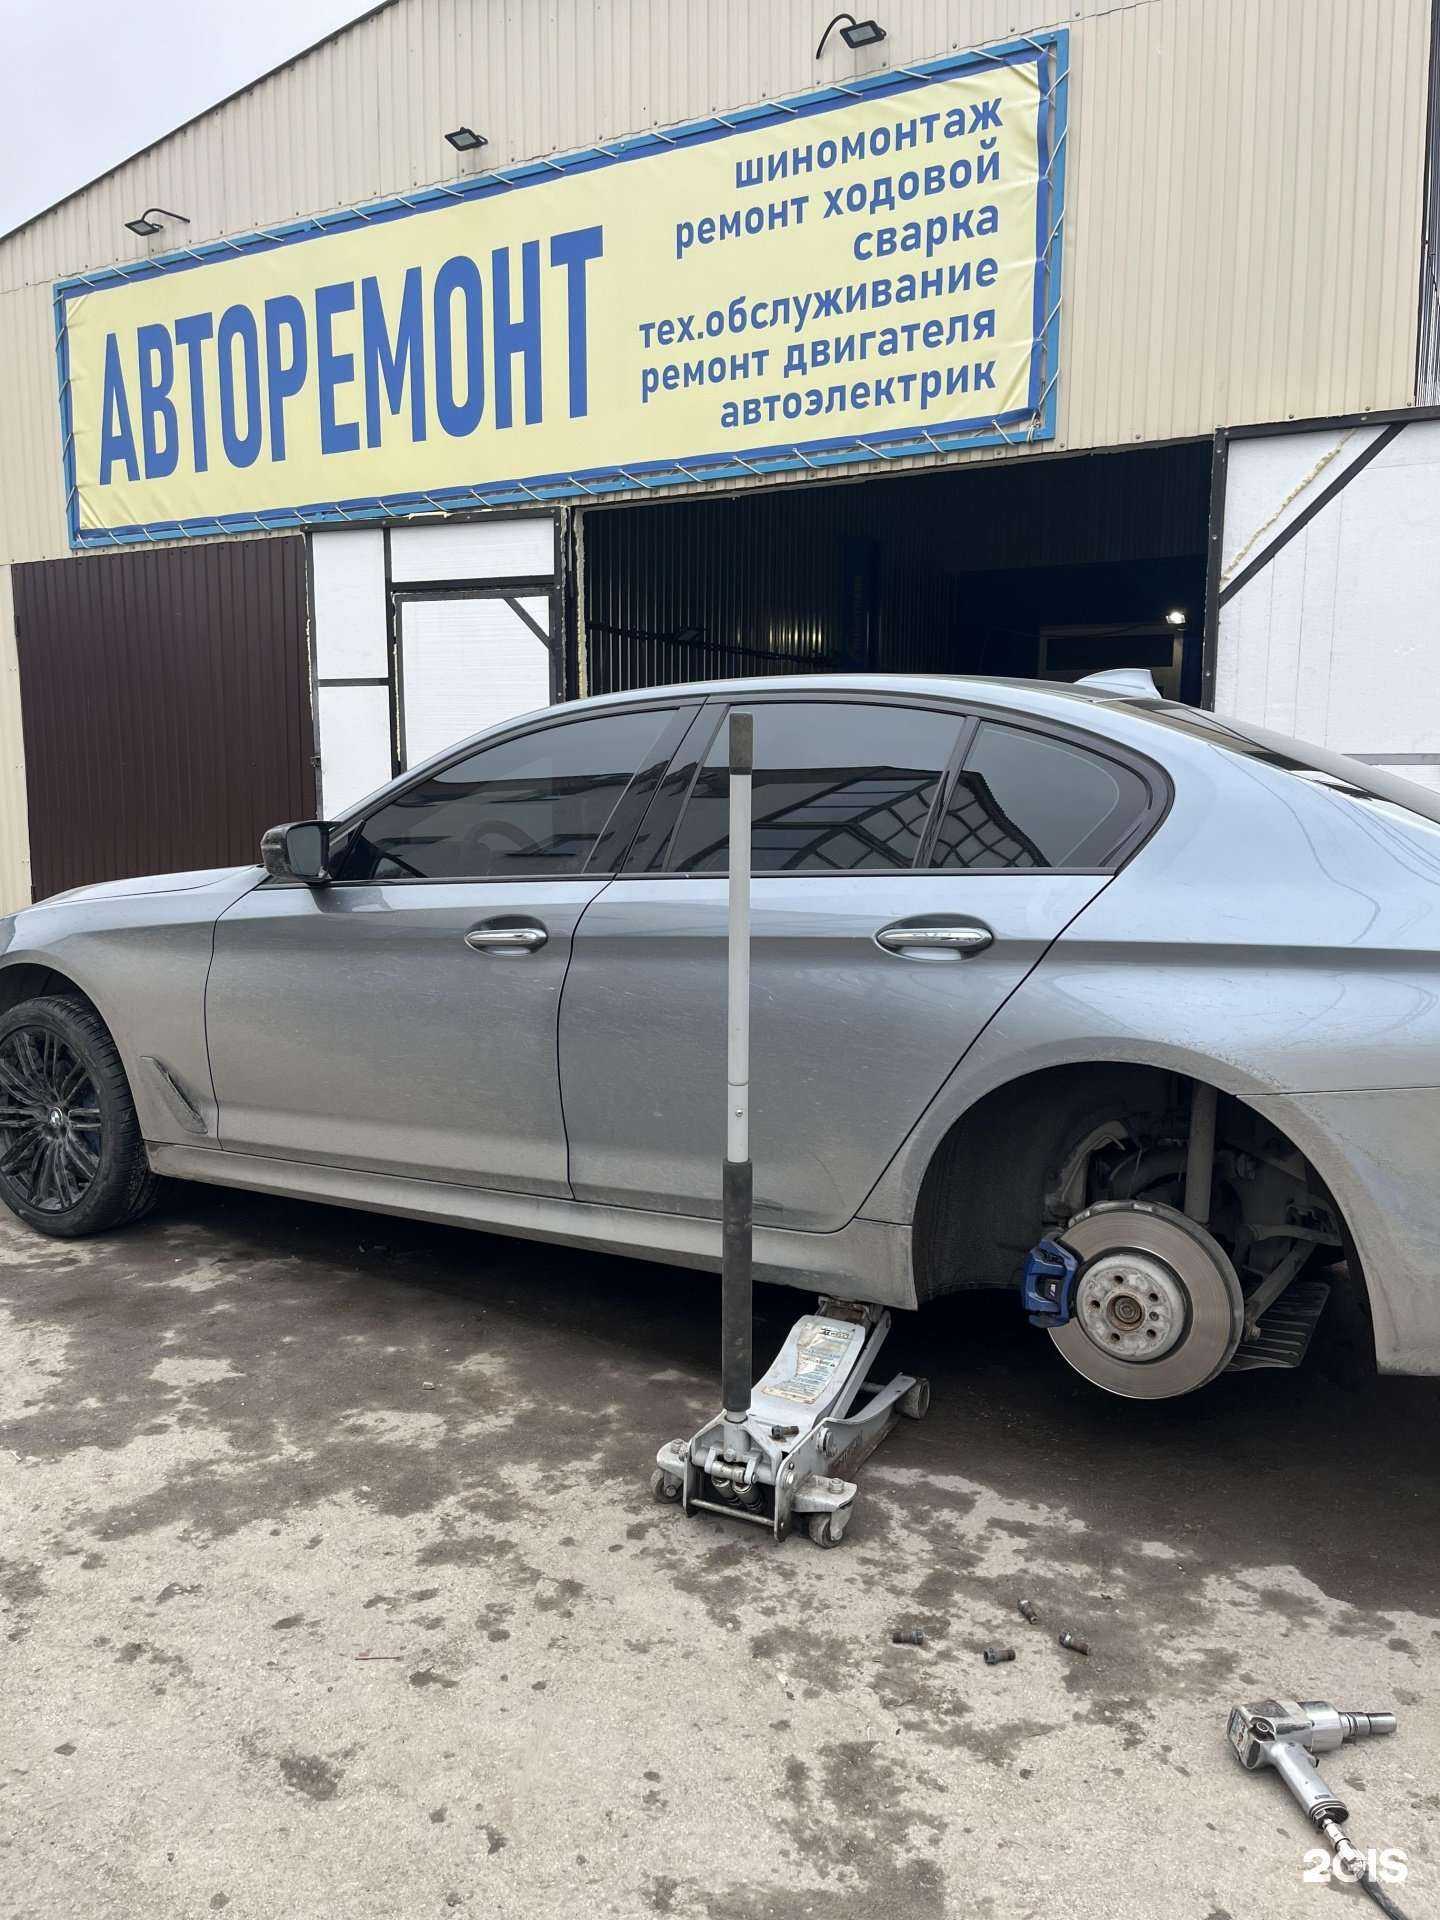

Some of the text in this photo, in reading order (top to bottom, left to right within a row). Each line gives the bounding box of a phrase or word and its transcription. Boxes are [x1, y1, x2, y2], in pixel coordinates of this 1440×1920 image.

[735, 97, 1003, 189] шиномонтаж
[676, 136, 1001, 260] ремонт ходовой
[853, 204, 1000, 262] сварка
[639, 257, 999, 349] тех.обслуживание
[99, 225, 604, 486] АВТОРЕМОНТ
[641, 309, 996, 403] ремонт двигателя
[720, 360, 997, 429] автоэлектрик
